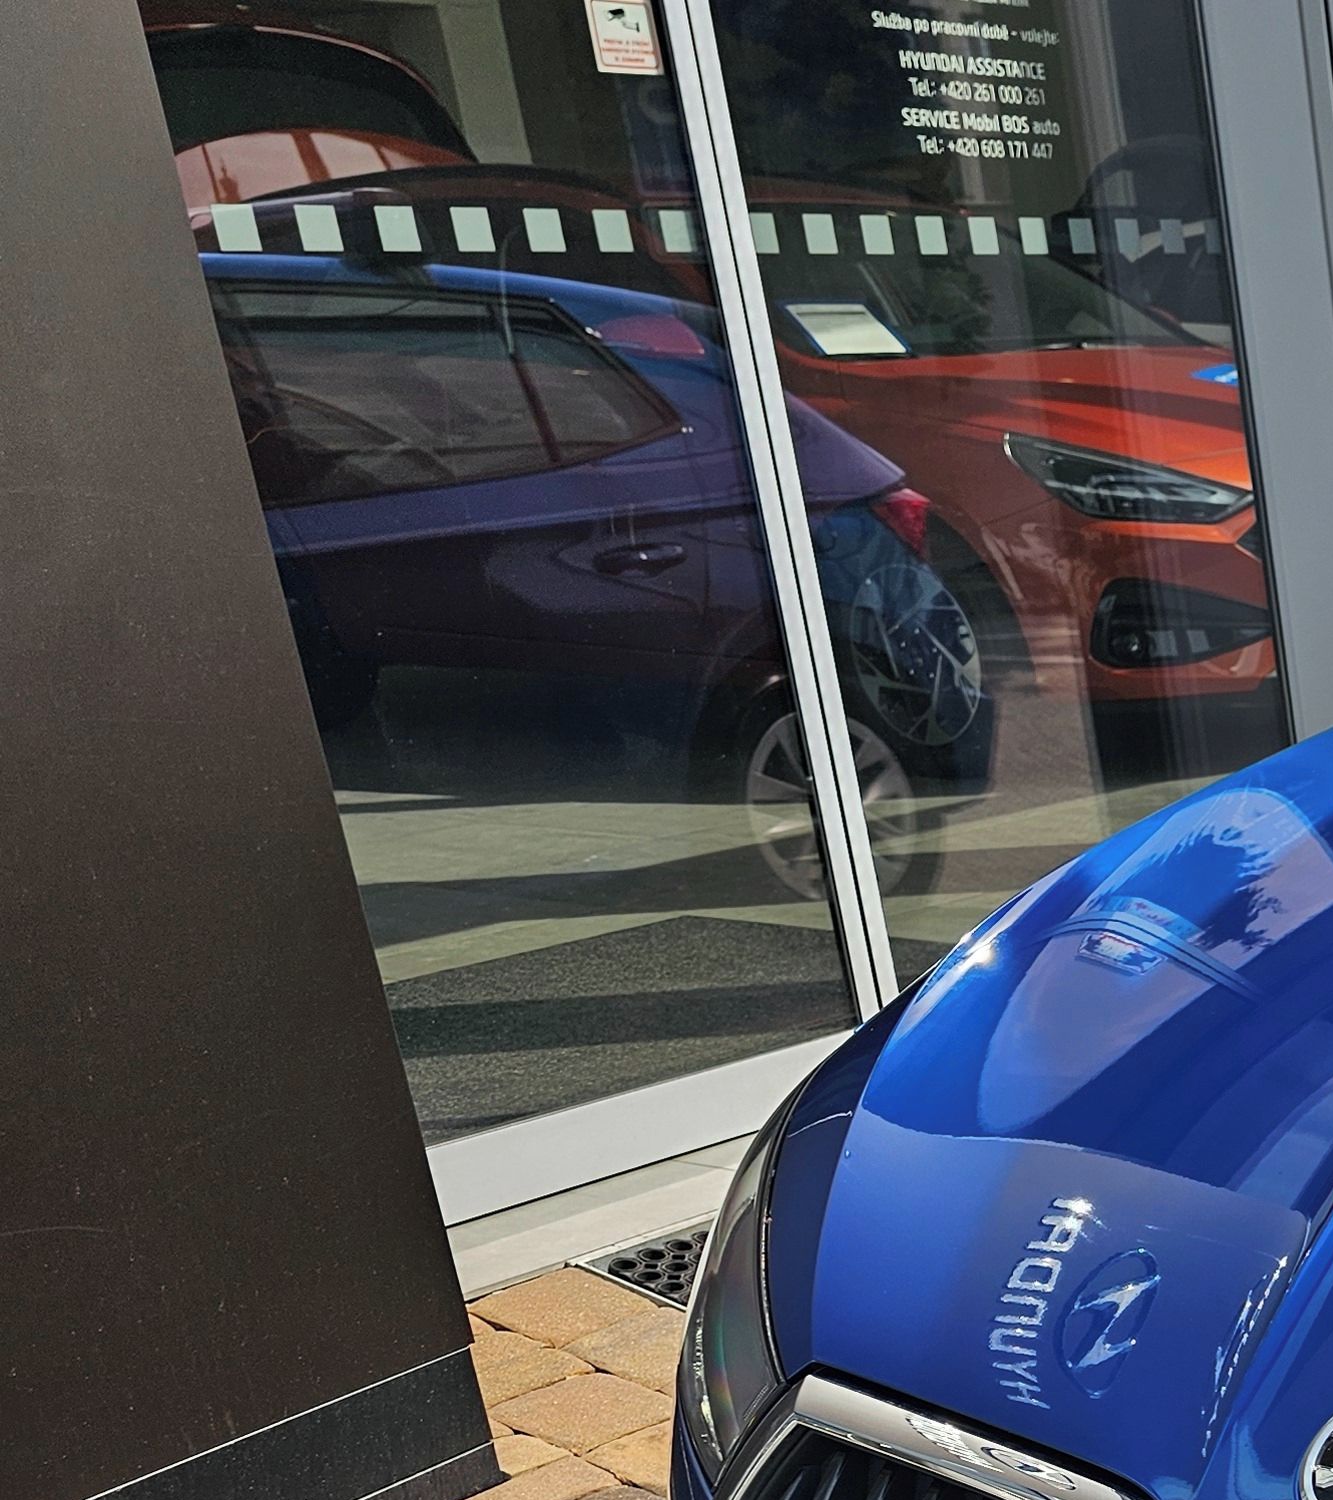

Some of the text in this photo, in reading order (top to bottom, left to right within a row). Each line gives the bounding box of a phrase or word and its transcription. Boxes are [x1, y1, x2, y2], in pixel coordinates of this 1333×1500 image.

[913, 18, 929, 34] po
[898, 50, 1046, 80] HYUNDAI ASSISTANCE
[939, 80, 972, 100] +420
[972, 82, 996, 102] 261
[998, 84, 1023, 104] 000
[901, 107, 1061, 136] SERVICE Mobil BOS auto
[947, 137, 980, 157] +420
[1007, 140, 1029, 159] 171
